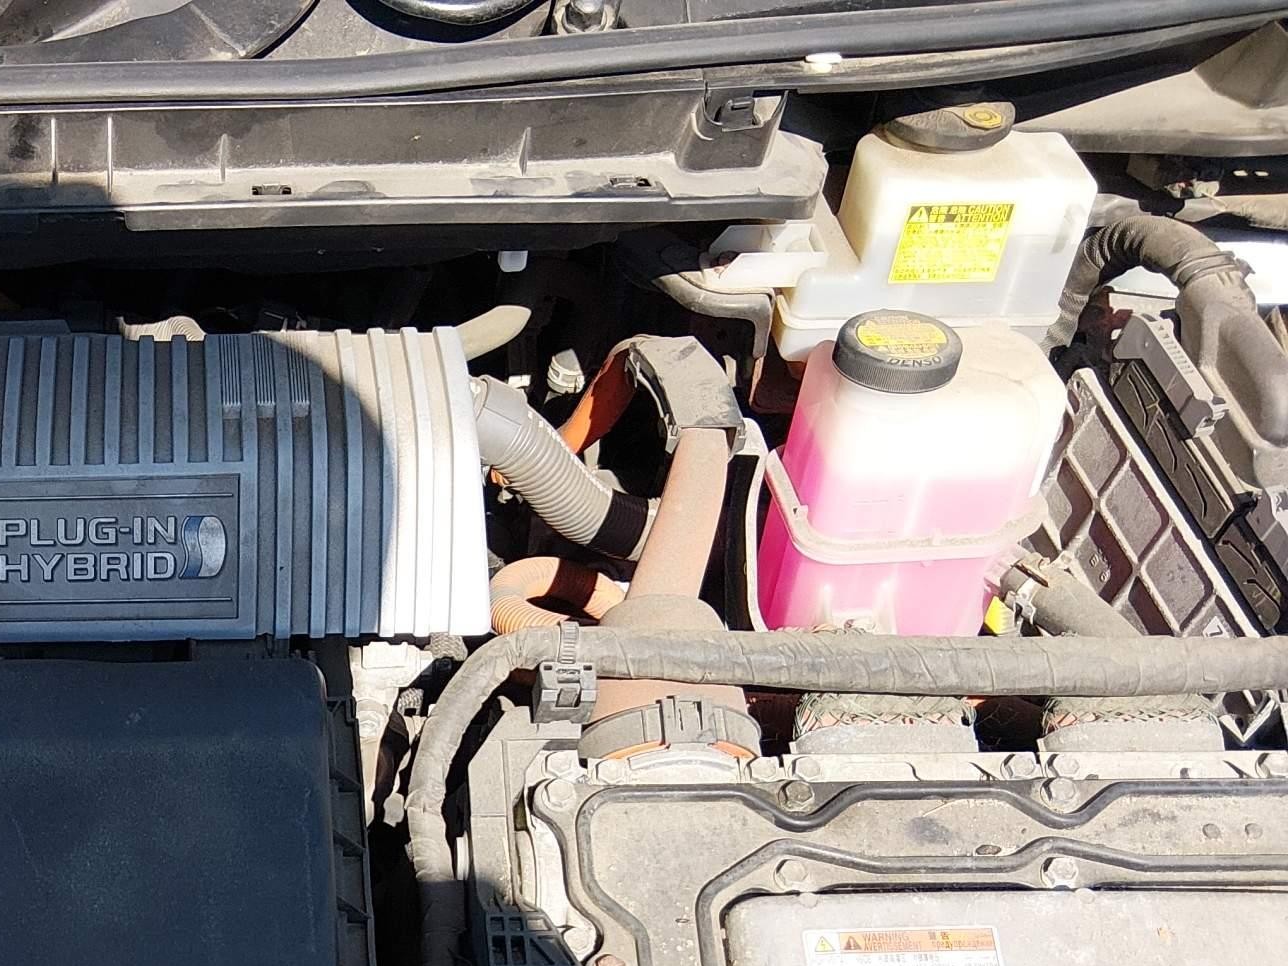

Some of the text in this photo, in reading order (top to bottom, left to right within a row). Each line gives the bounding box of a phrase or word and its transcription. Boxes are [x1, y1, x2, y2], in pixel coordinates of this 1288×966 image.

[967, 204, 1010, 214] CAUTION
[953, 213, 1008, 223] ATTENTION
[886, 355, 942, 368] DENSO
[862, 932, 910, 941] WARNING
